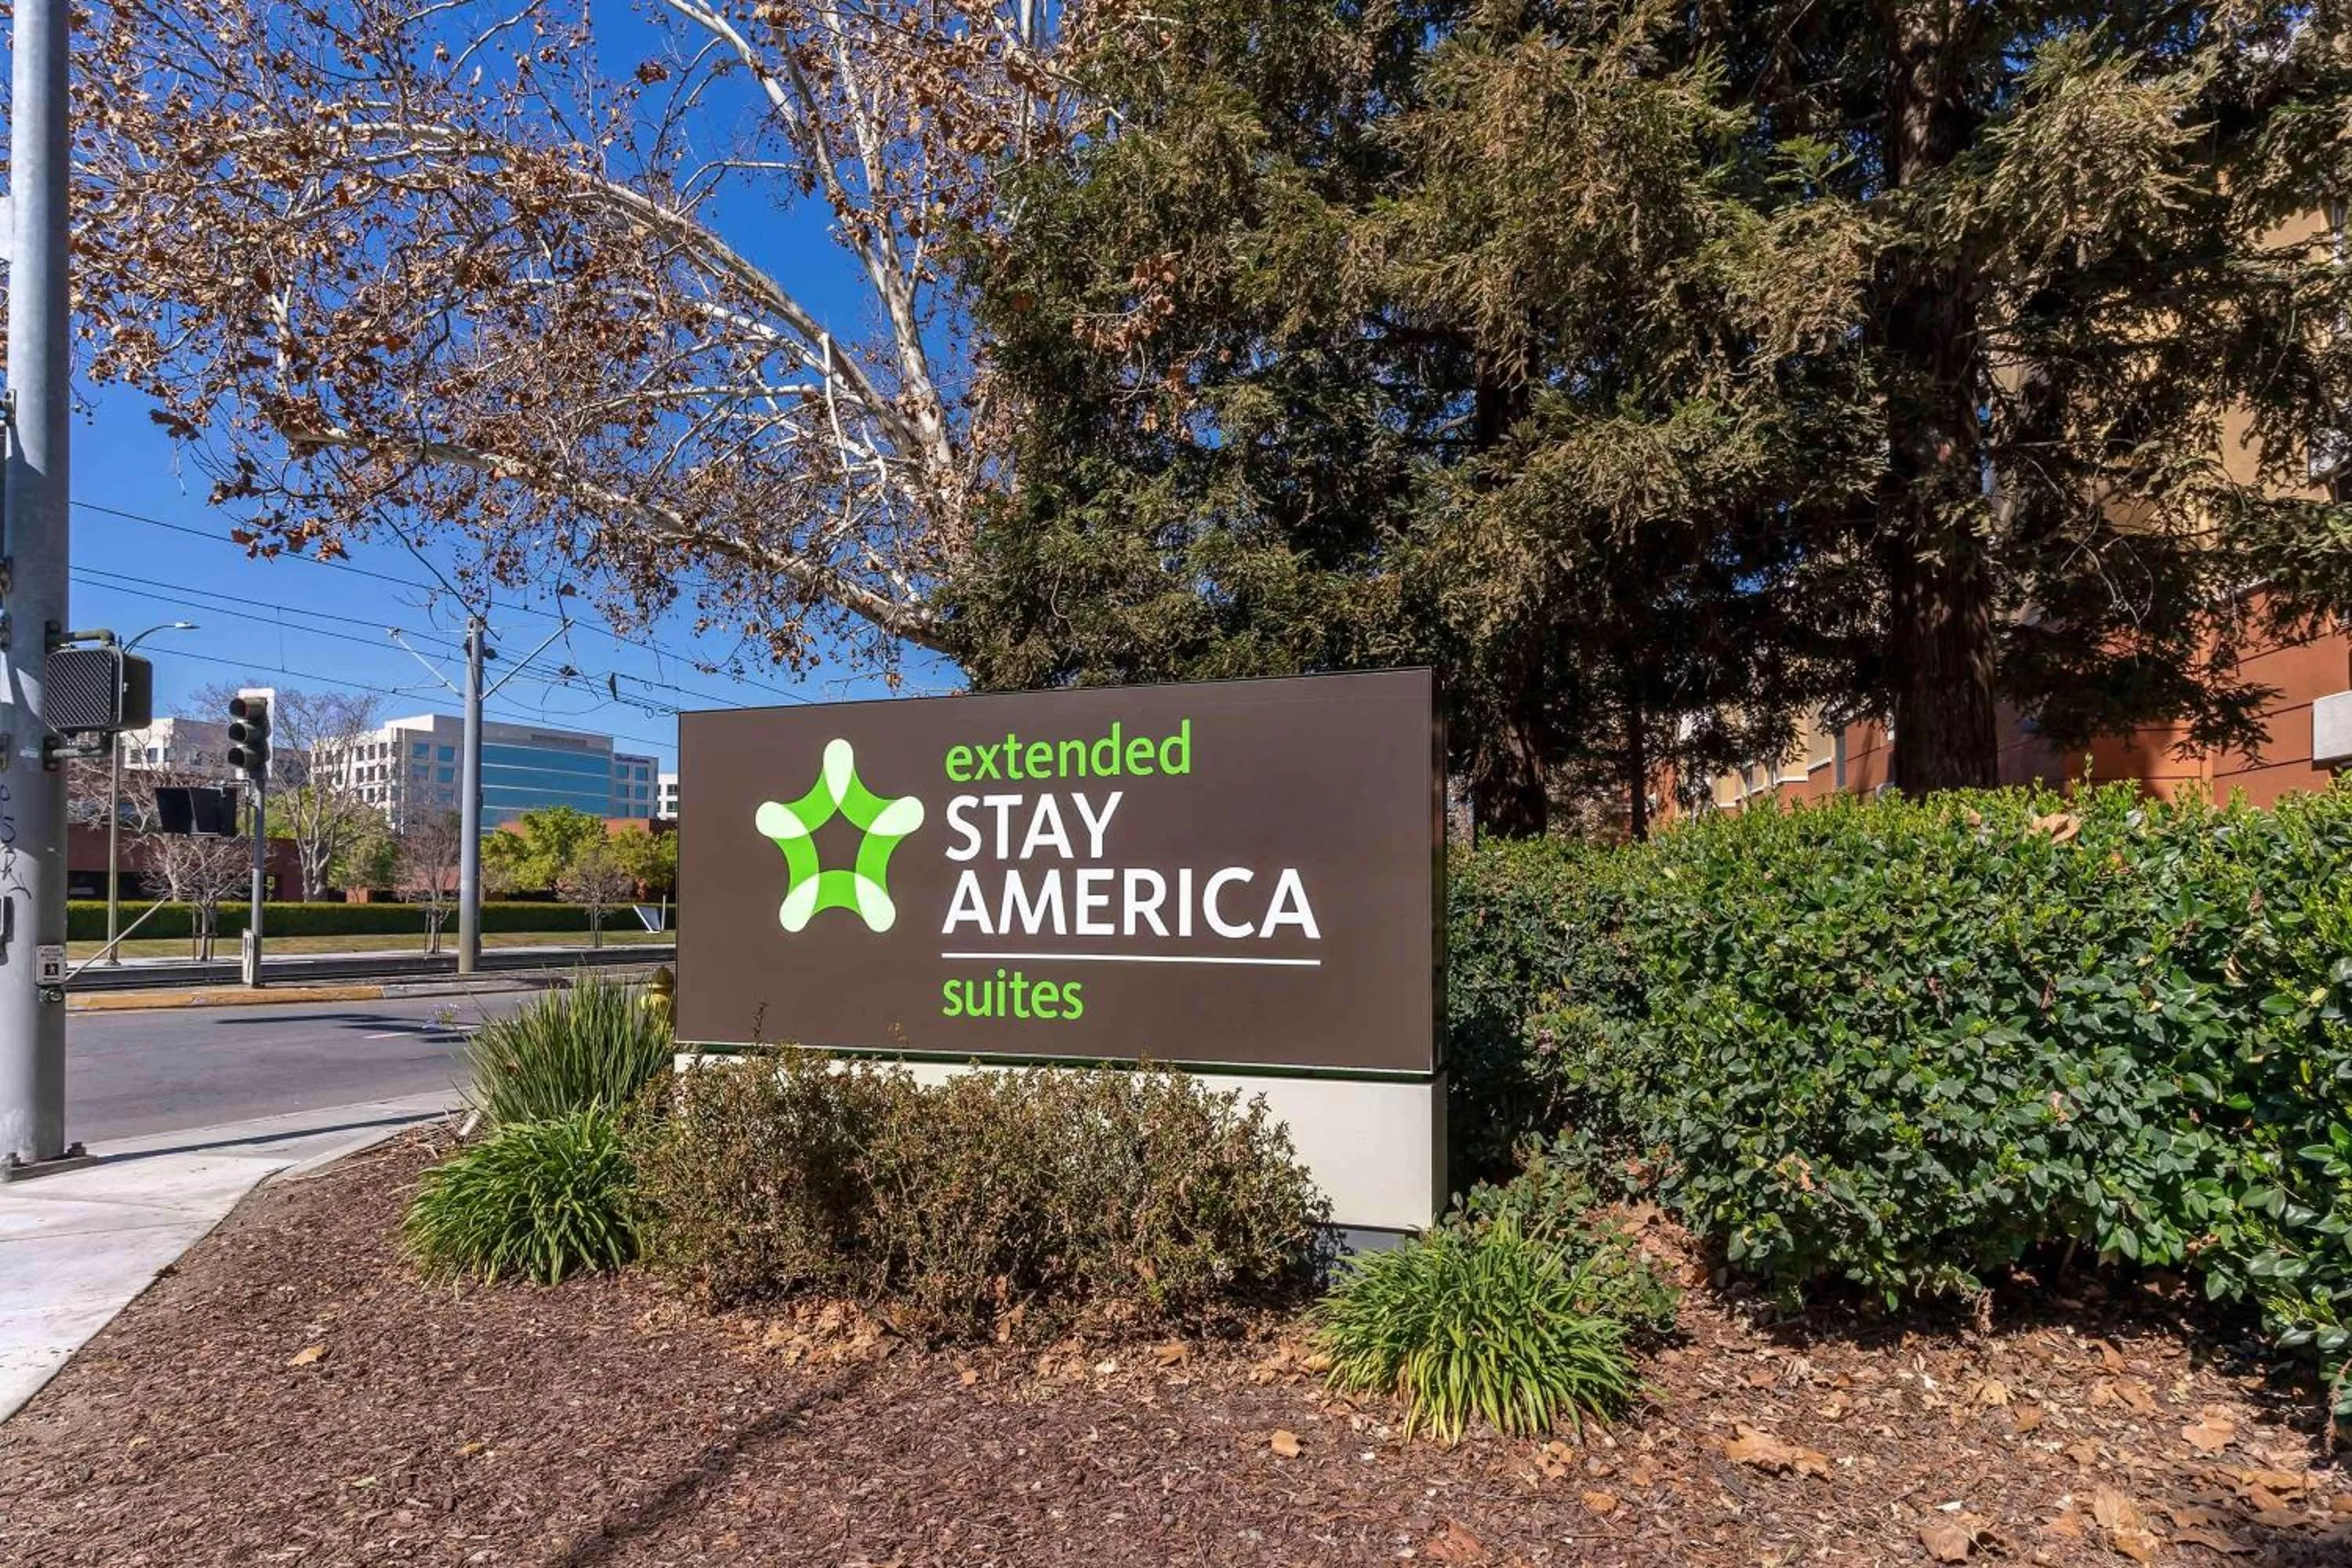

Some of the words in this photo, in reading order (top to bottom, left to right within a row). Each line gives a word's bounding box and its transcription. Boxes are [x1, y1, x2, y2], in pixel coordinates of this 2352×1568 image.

[945, 719, 1192, 782] extended
[945, 791, 1123, 861] STAY
[941, 866, 1321, 939] AMERICA
[942, 969, 1084, 1019] suites
